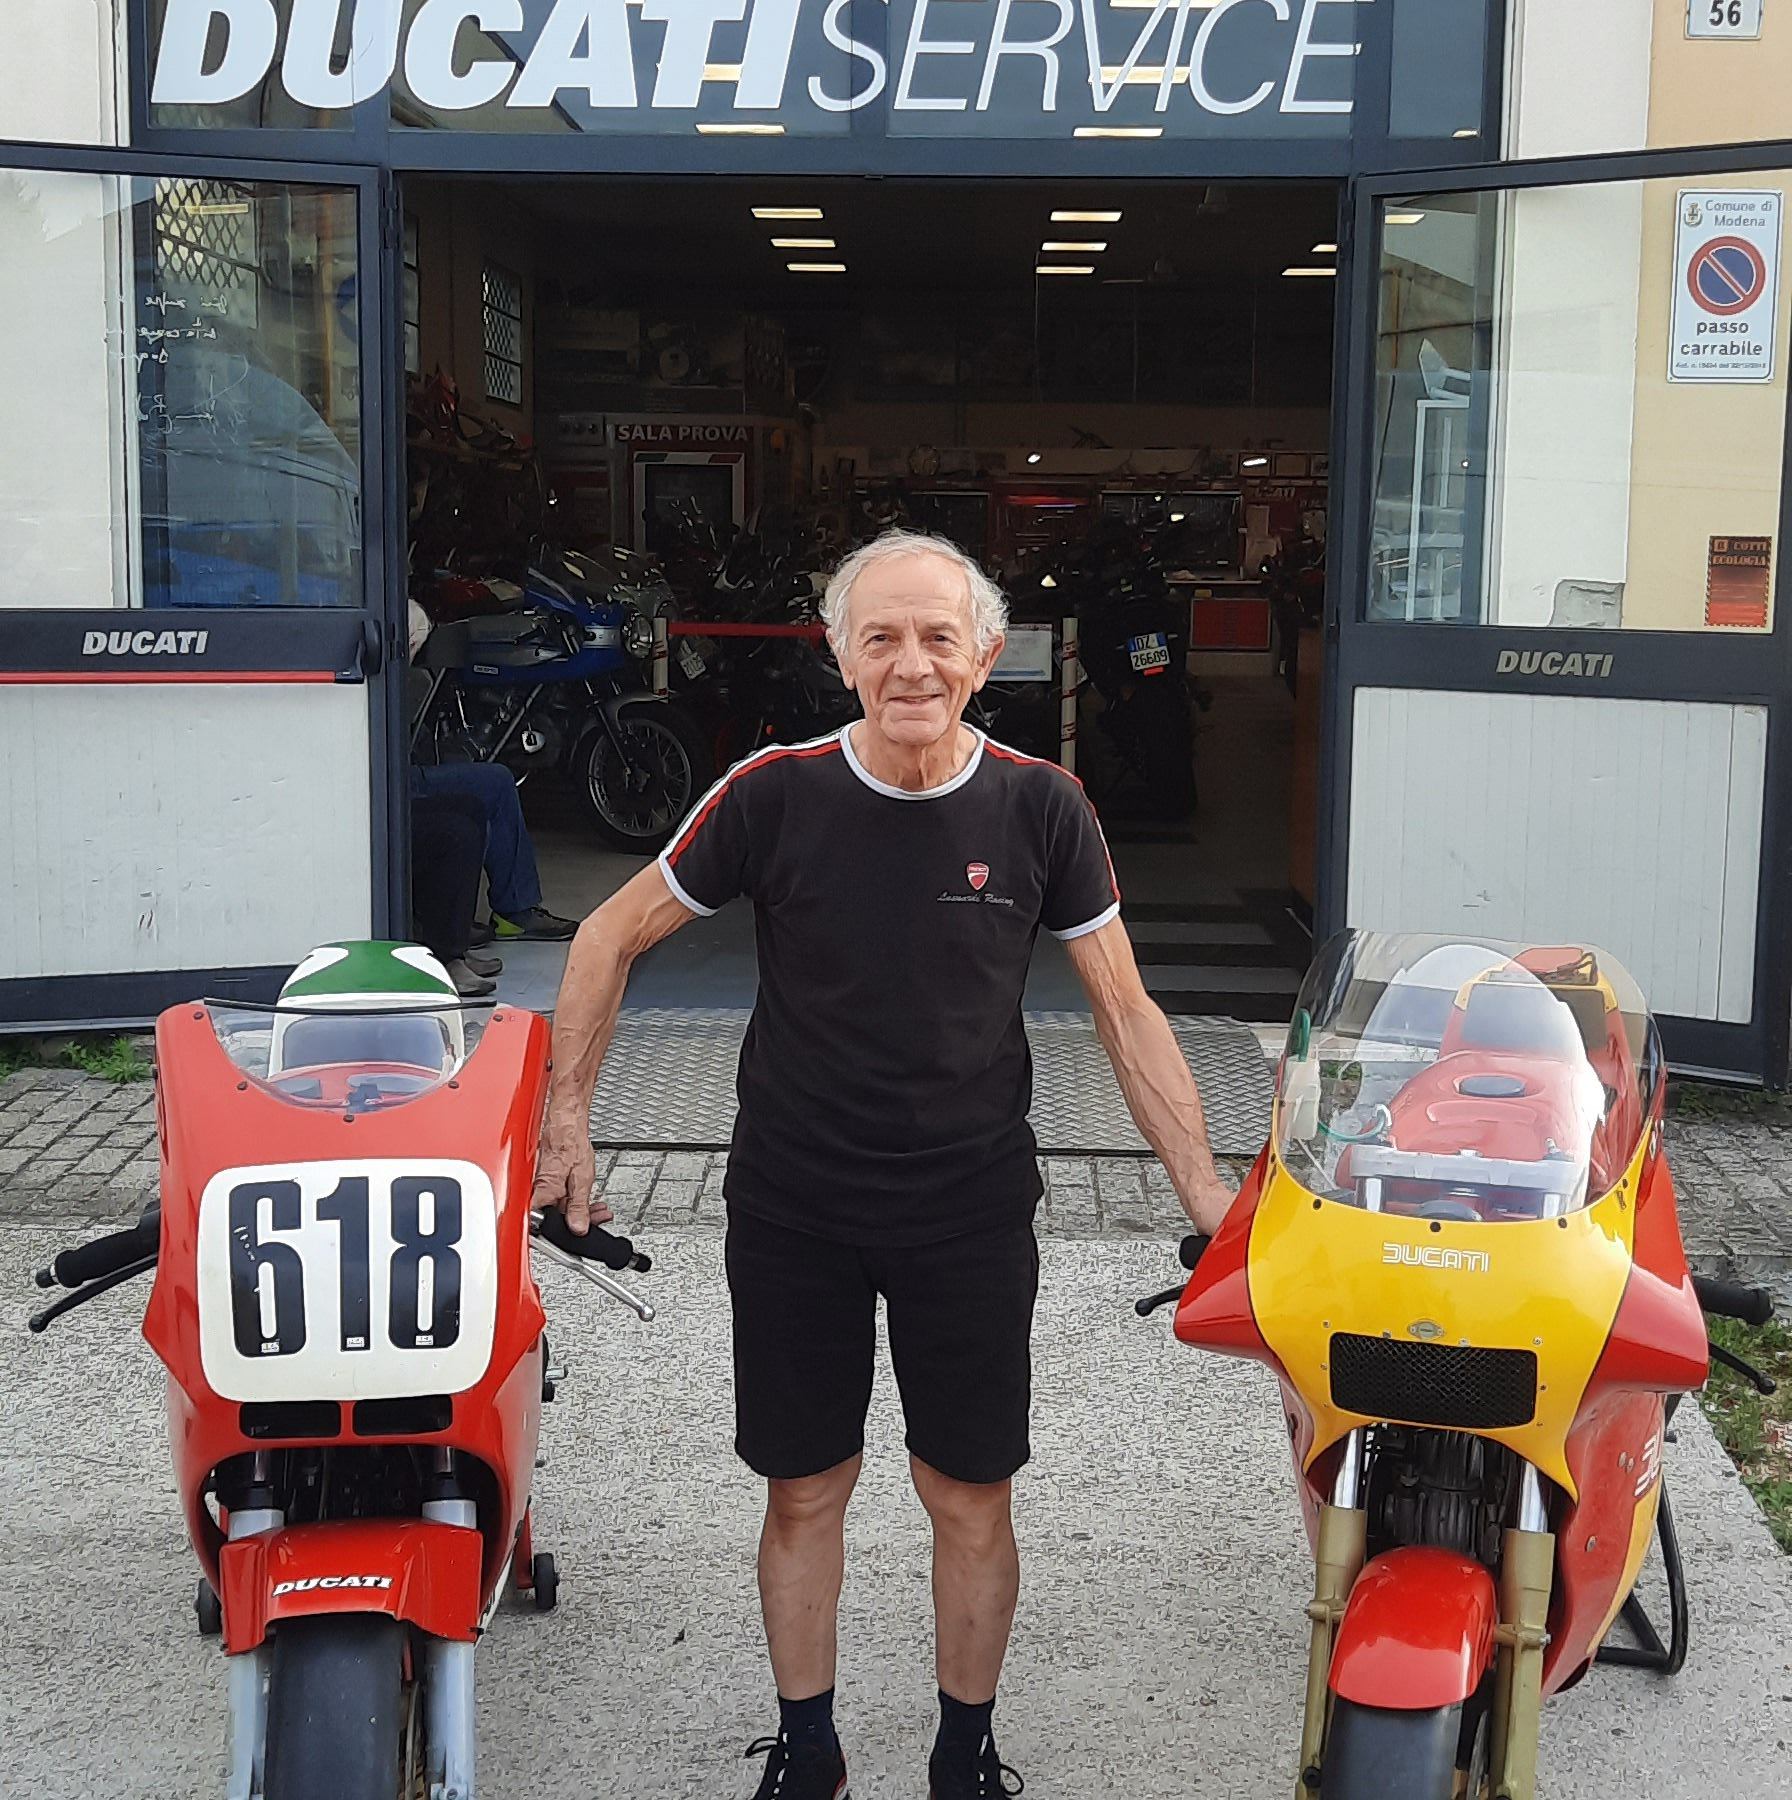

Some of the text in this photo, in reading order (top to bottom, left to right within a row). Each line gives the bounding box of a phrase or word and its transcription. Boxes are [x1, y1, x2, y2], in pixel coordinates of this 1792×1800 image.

[1708, 0, 1741, 26] 56
[151, 0, 1357, 114] DUCATI SERVICE
[1705, 199, 1773, 212] Comune di
[1714, 215, 1766, 227] Modena
[1697, 322, 1749, 336] passo
[1680, 341, 1763, 356] carrabile
[617, 424, 748, 442] SALA PROVA
[82, 630, 208, 655] DUCATI
[1496, 650, 1614, 677] DUCATI
[229, 1176, 463, 1358] 618
[1382, 1242, 1489, 1273] DUCATI
[272, 1576, 393, 1597] DUCATI
